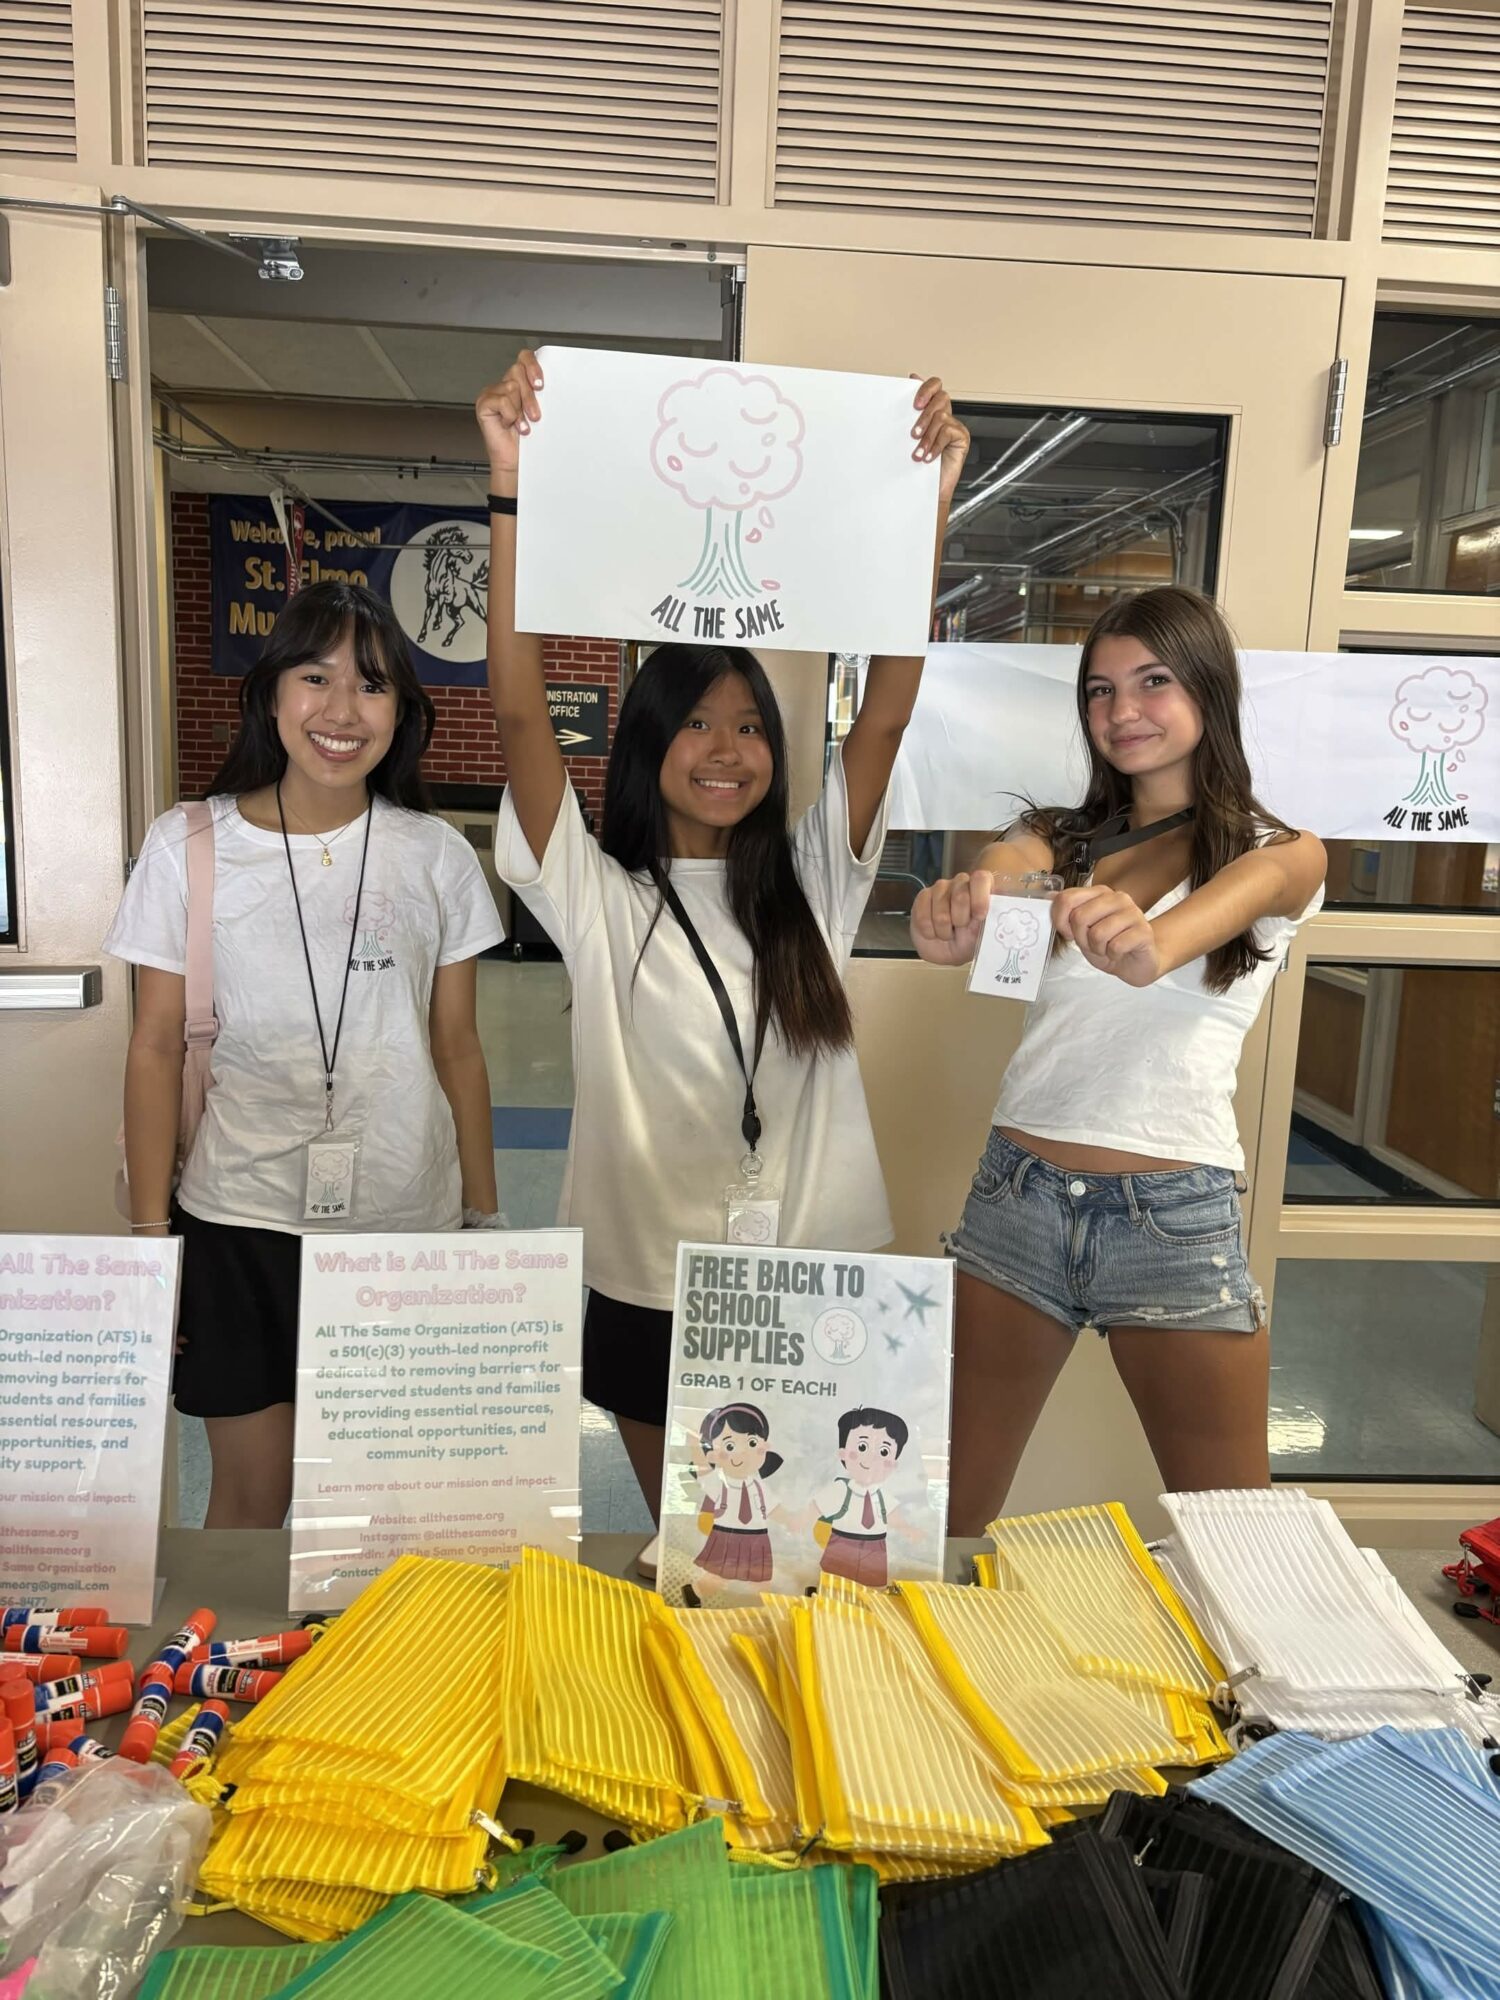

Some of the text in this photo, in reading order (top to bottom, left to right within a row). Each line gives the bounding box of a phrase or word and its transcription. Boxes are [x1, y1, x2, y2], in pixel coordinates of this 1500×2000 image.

[230, 519, 321, 549] Welcoe,
[244, 556, 285, 591] St.
[651, 595, 784, 639] ALL THE SAME
[547, 690, 598, 704] NISTRATION
[549, 705, 580, 717] OFFICE
[1383, 806, 1469, 831] ALL THE SAME
[362, 960, 375, 971] THE
[378, 956, 396, 970] SAME
[0, 1252, 162, 1276] All The Same
[314, 1249, 568, 1273] What is All The Same
[688, 1254, 865, 1298] FREE BACK TO
[0, 1288, 116, 1311] nization?
[356, 1282, 527, 1312] Organization?
[685, 1290, 786, 1329] SCHOOL
[0, 1329, 153, 1346] Organization (ATS) is
[315, 1320, 563, 1338] All The Same Organization (ATS) is
[329, 1341, 549, 1361] a 501(c)(3) youth-led nonprofit
[683, 1325, 805, 1367] SUPPLIES
[0, 1350, 137, 1366] outh-led nonprofit
[61, 1372, 121, 1386] barriers
[125, 1372, 148, 1386] for
[316, 1361, 561, 1379] dedicated to removing barriers for
[315, 1381, 561, 1399] underserved students and families
[680, 1372, 838, 1397] GRAB 1 OF EACH!
[56, 1393, 85, 1406] and
[88, 1393, 146, 1407] families
[0, 1414, 137, 1430] ssential resources,
[321, 1403, 554, 1423] by providing essential resources,
[328, 1421, 546, 1441] educational opportunities, and
[101, 1436, 129, 1449] and
[366, 1444, 508, 1462] community support.
[24, 1458, 86, 1472] support.
[318, 1476, 557, 1493] Learn more about our mission and impact:
[20, 1492, 65, 1503] mission
[68, 1492, 90, 1503] and
[92, 1492, 137, 1505] impact:
[419, 1511, 505, 1523] allthesame.org
[360, 1532, 421, 1543] Instagram:
[433, 1546, 464, 1557] Same
[37, 1563, 116, 1575] Organization
